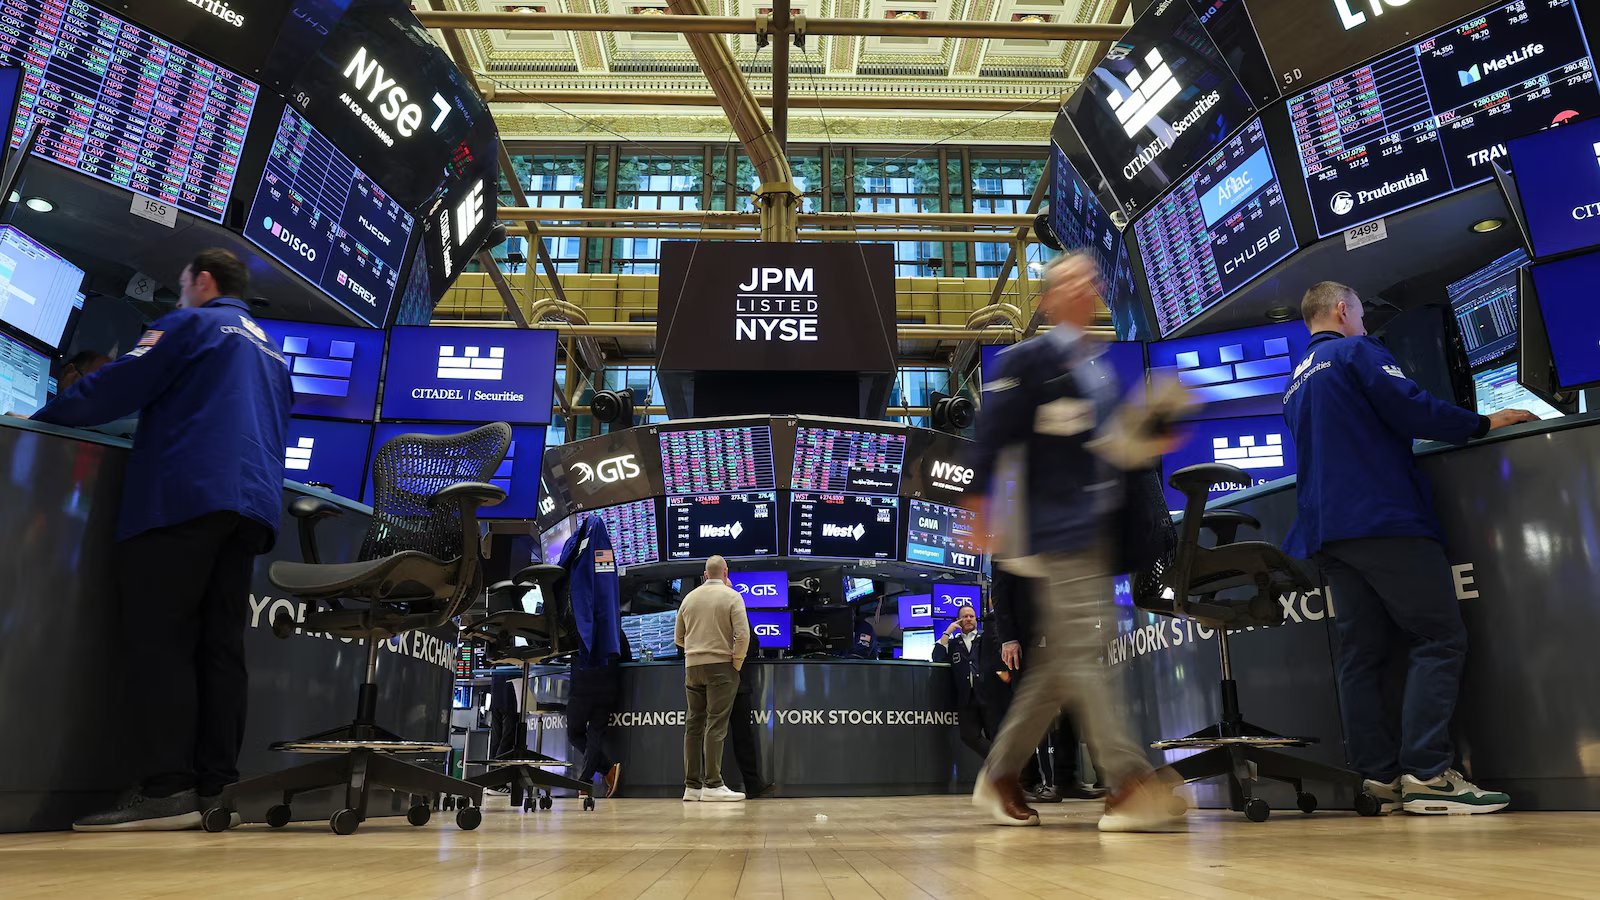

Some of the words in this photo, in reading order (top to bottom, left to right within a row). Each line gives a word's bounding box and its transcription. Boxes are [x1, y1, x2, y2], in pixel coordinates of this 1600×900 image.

[72, 0, 89, 12] ERO
[4, 8, 23, 20] COPL
[69, 8, 88, 20] EVAC
[124, 24, 140, 36] GNK
[1460, 17, 1487, 33] 78.5900
[61, 32, 78, 44] EVTL
[122, 32, 140, 44] GROV
[1470, 29, 1490, 42] 78.70
[58, 41, 76, 52] EXK
[1419, 39, 1436, 50] MET
[56, 50, 68, 58] FN
[1432, 44, 1454, 58] 74,350
[114, 56, 122, 64] HI
[1483, 43, 1545, 75] MetLife
[111, 64, 128, 74] HIPO
[168, 62, 182, 74] MSB
[1564, 59, 1588, 74] 280.69
[108, 72, 125, 82] HLLY
[217, 68, 232, 79] PEW
[1567, 71, 1593, 86] 279.69
[106, 80, 122, 90] HPP
[162, 78, 180, 89] NOTE
[214, 76, 223, 84] PL
[1330, 79, 1344, 88] USB
[1524, 75, 1547, 89] 280.40
[45, 82, 60, 94] FSS
[104, 88, 122, 98] HSHP
[160, 86, 178, 96] NRDY
[42, 90, 62, 102] FUBO
[158, 93, 174, 104] NUE
[1477, 90, 1507, 107] 280.6300
[1526, 88, 1550, 101] 281.48
[40, 98, 59, 110] GATX
[1336, 100, 1352, 110] WCN
[1488, 103, 1510, 116] 281.29
[37, 107, 56, 120] GCTS
[206, 105, 220, 116] RBA
[1338, 108, 1351, 118] WM
[1439, 110, 1456, 122] TRV
[96, 113, 114, 124] JENA
[151, 118, 168, 128] ODC
[204, 114, 215, 122] RM
[1296, 119, 1308, 128] SSB
[1340, 116, 1356, 126] WSO
[1452, 117, 1474, 129] 49,630
[148, 126, 166, 136] ODV
[202, 120, 216, 132] RRX
[1297, 127, 1310, 135] TFC
[1412, 120, 1433, 132] 117.17
[91, 129, 109, 140] JOBY
[200, 129, 213, 139] SKE
[1123, 136, 1168, 181] CITADEL
[1172, 89, 1220, 137] Securities
[1416, 131, 1436, 144] 116.50
[88, 138, 104, 148] KEX
[144, 141, 160, 152] OPY
[86, 146, 104, 157] LAW
[142, 150, 154, 158] OR
[1382, 144, 1402, 156] 117.14
[84, 154, 99, 164] LXP
[139, 157, 156, 168] PAAS
[192, 152, 206, 162] SRL
[1349, 157, 1368, 169] 117.14
[80, 163, 98, 174] LZM
[137, 164, 148, 174] PB
[190, 160, 204, 170] SST
[1308, 163, 1322, 174] PRU
[134, 174, 150, 184] PDS
[189, 168, 202, 178] TDS
[187, 176, 200, 186] TEX
[1357, 168, 1429, 204] Prudential
[1218, 170, 1250, 206] Aflac
[182, 192, 196, 202] TSQ
[144, 200, 166, 216] 155
[358, 215, 392, 246] NUCOR
[1350, 222, 1378, 240] 2499
[280, 228, 316, 262] DISCO
[1224, 228, 1280, 274] CHUBB
[738, 268, 814, 292] JPM
[348, 278, 376, 307] TEREX
[736, 300, 818, 312] LISTED
[736, 318, 818, 341] NYSE
[412, 388, 463, 400] CITADEL
[474, 390, 524, 402] Securities
[596, 454, 640, 482] GTS
[670, 496, 684, 504] WST
[918, 517, 938, 530] CAVA
[700, 524, 730, 538] West
[822, 524, 854, 538] West
[951, 552, 976, 567] YETI
[1107, 634, 1127, 667] NEW
[1128, 620, 1169, 658] YORK
[542, 716, 564, 730] YORK
[776, 710, 824, 724] YORK
[828, 710, 883, 725] STOCK
[886, 710, 959, 726] EXCHANGE
